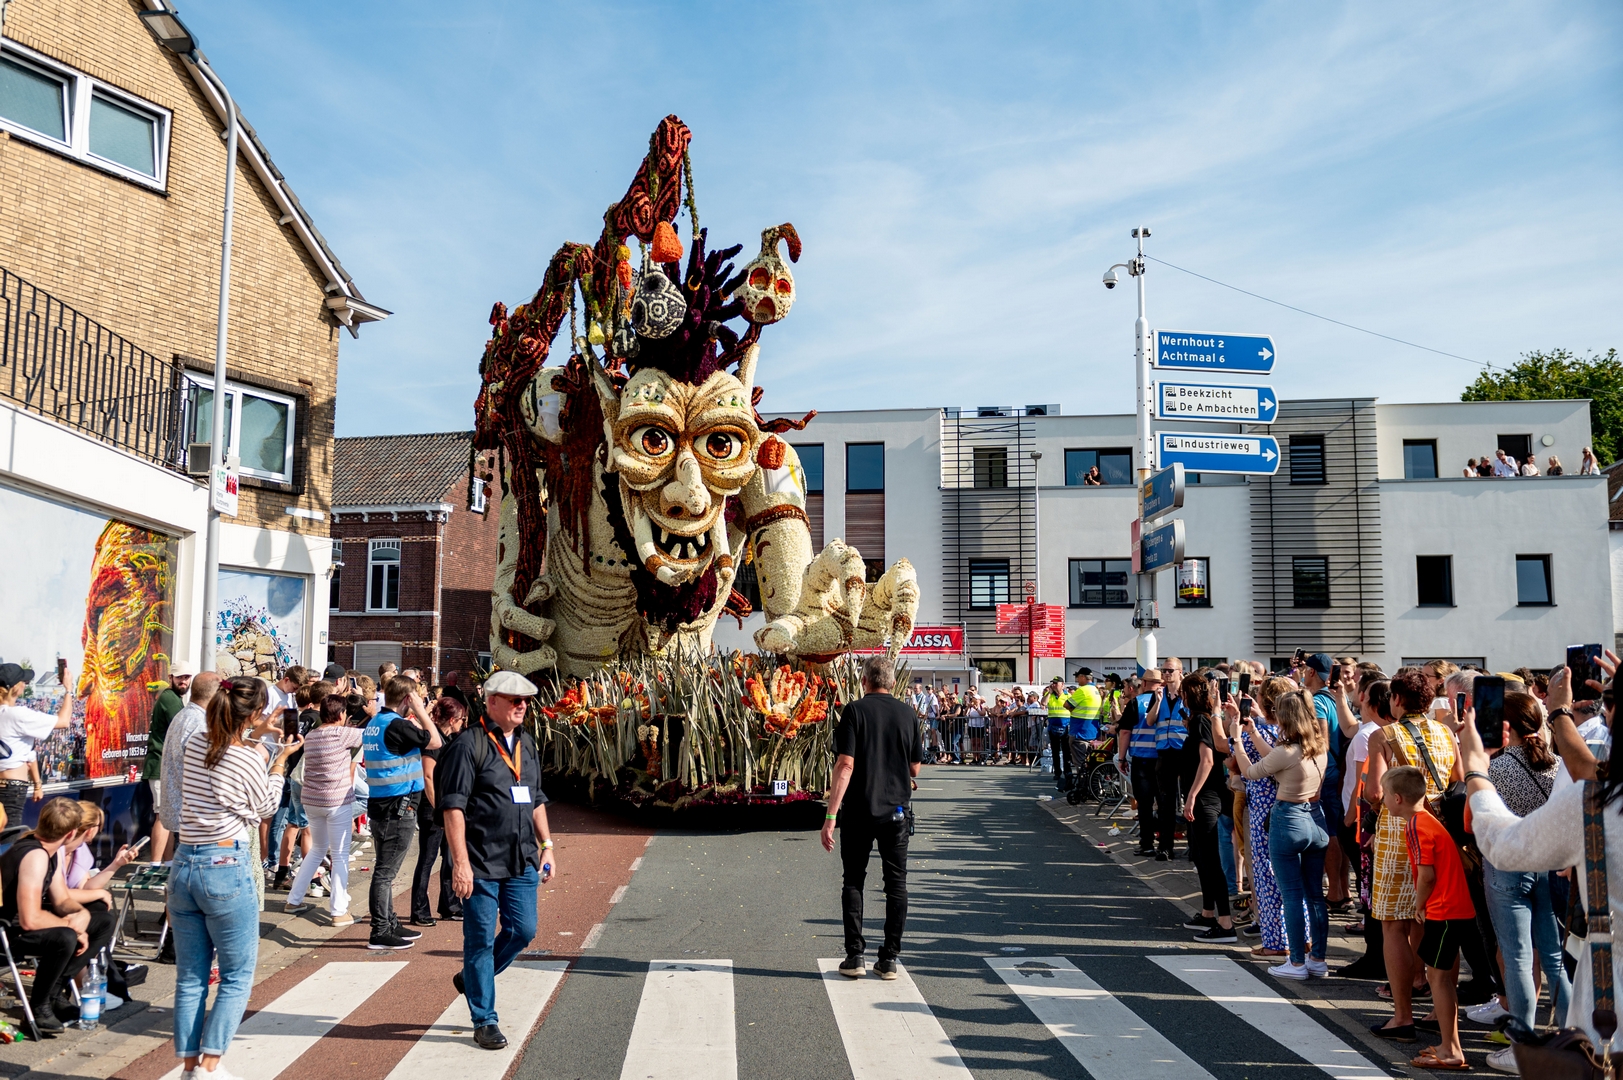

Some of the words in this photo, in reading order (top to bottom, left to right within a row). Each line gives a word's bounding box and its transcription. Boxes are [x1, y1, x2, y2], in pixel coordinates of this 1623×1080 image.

[1161, 335, 1214, 348] Wernhout
[1217, 340, 1225, 348] 2
[1161, 350, 1216, 363] Achtmaal
[1219, 355, 1225, 363] 6
[1179, 388, 1232, 399] Beekzicht
[1179, 402, 1193, 411] De
[1196, 403, 1256, 414] Ambachten
[1180, 439, 1250, 452] Industrieweg
[126, 732, 142, 742] Vincent
[102, 748, 121, 759] Geboren
[776, 782, 786, 790] 18
